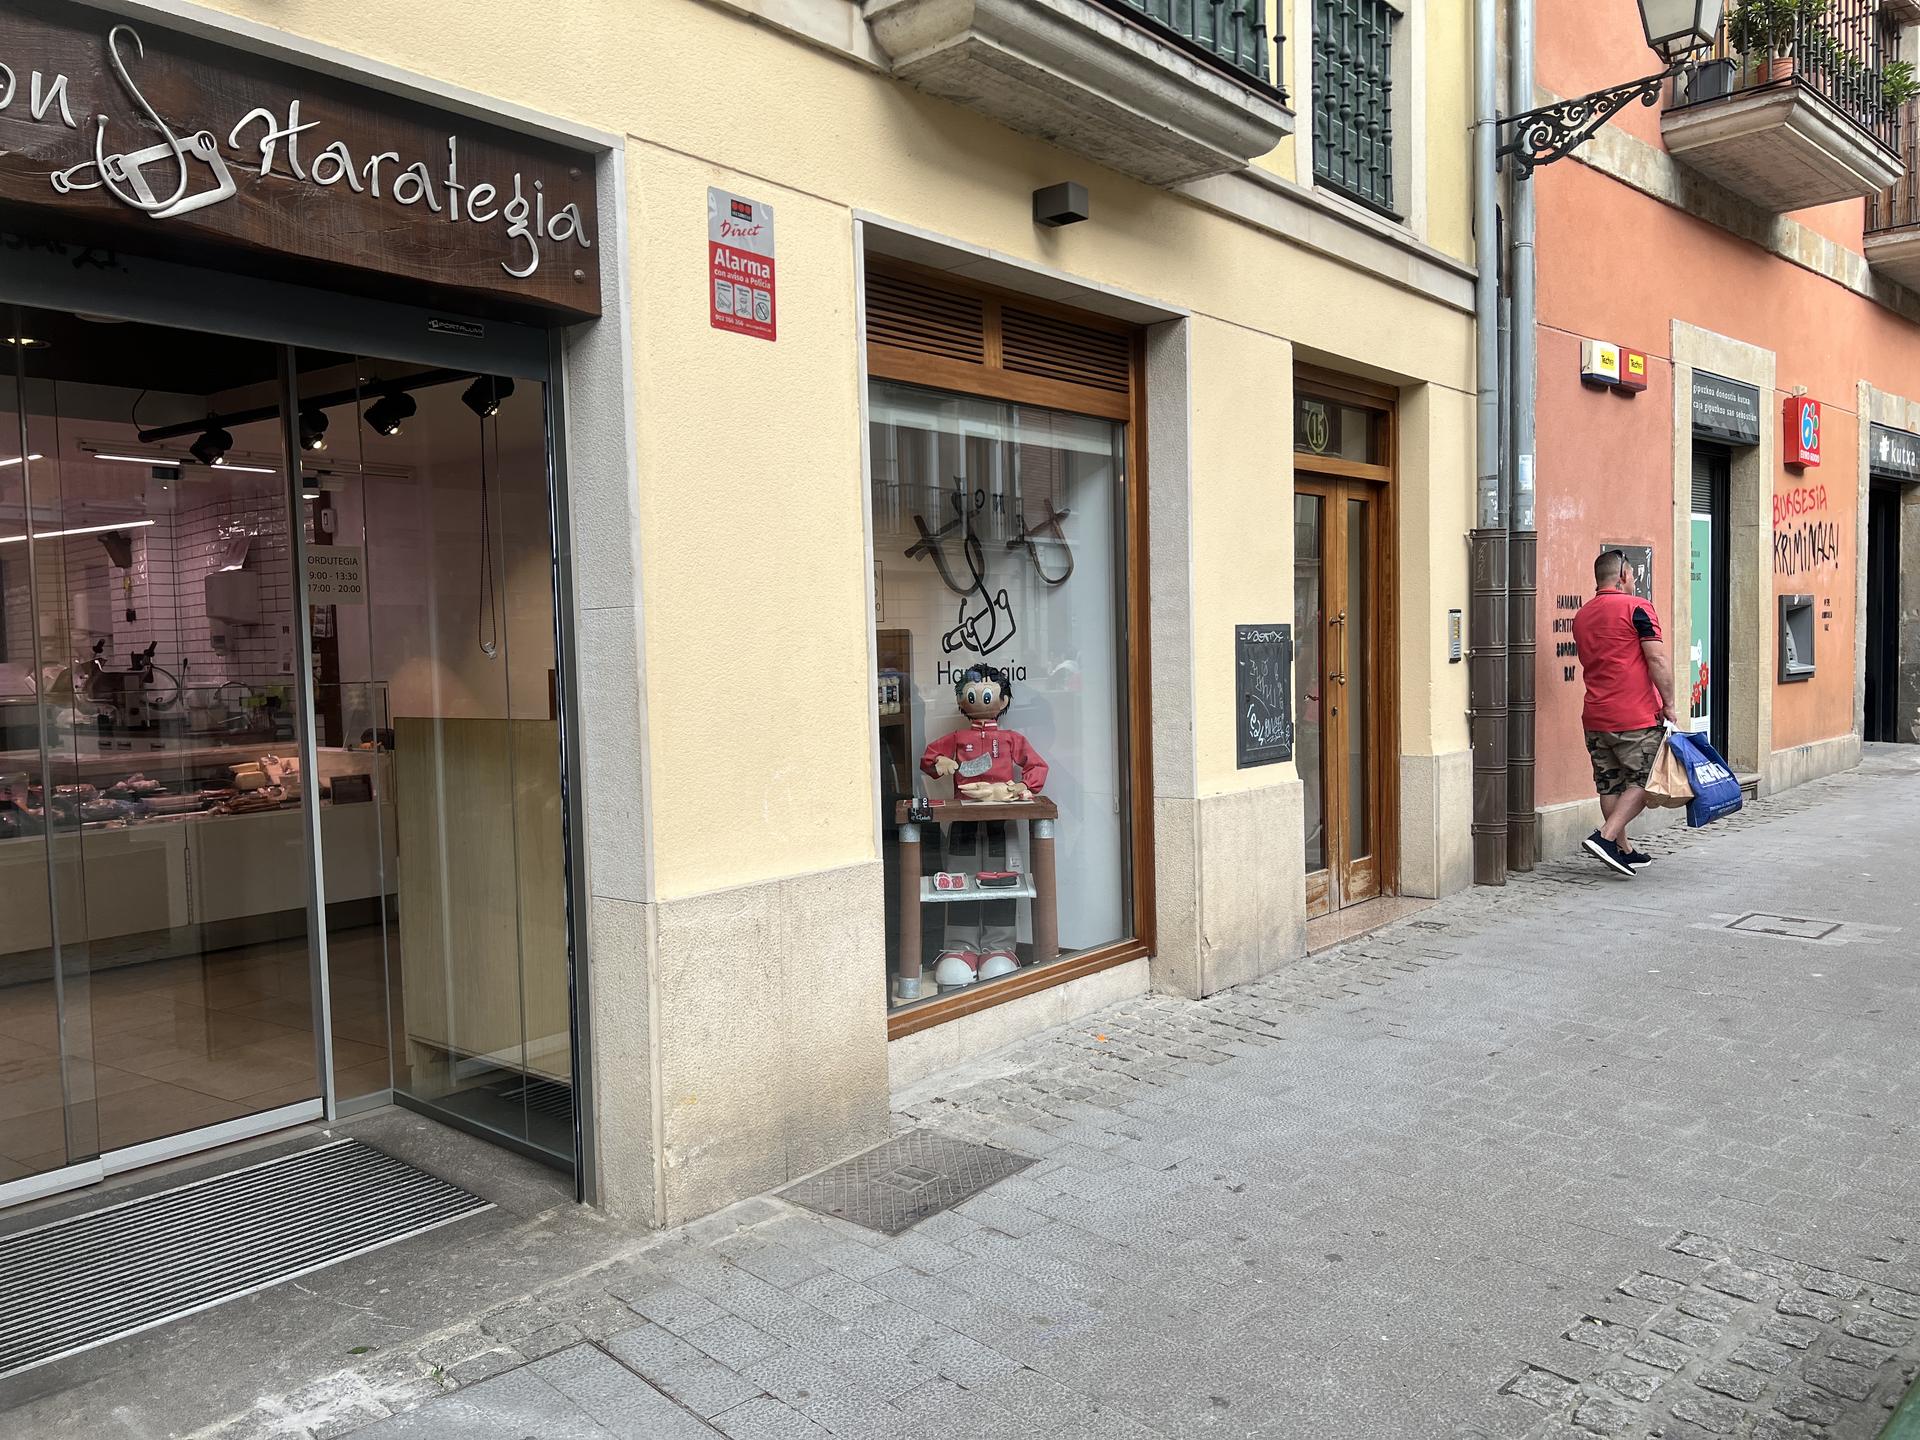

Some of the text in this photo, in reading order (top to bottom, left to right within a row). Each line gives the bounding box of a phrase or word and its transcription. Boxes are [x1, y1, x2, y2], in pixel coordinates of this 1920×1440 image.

[228, 99, 591, 278] Harategia
[714, 247, 771, 280] Alarma
[714, 268, 726, 278] con
[727, 271, 744, 284] aviso
[1891, 439, 1916, 467] kutxa
[307, 556, 359, 566] ORDUTEGIA
[335, 571, 358, 581] 13:30
